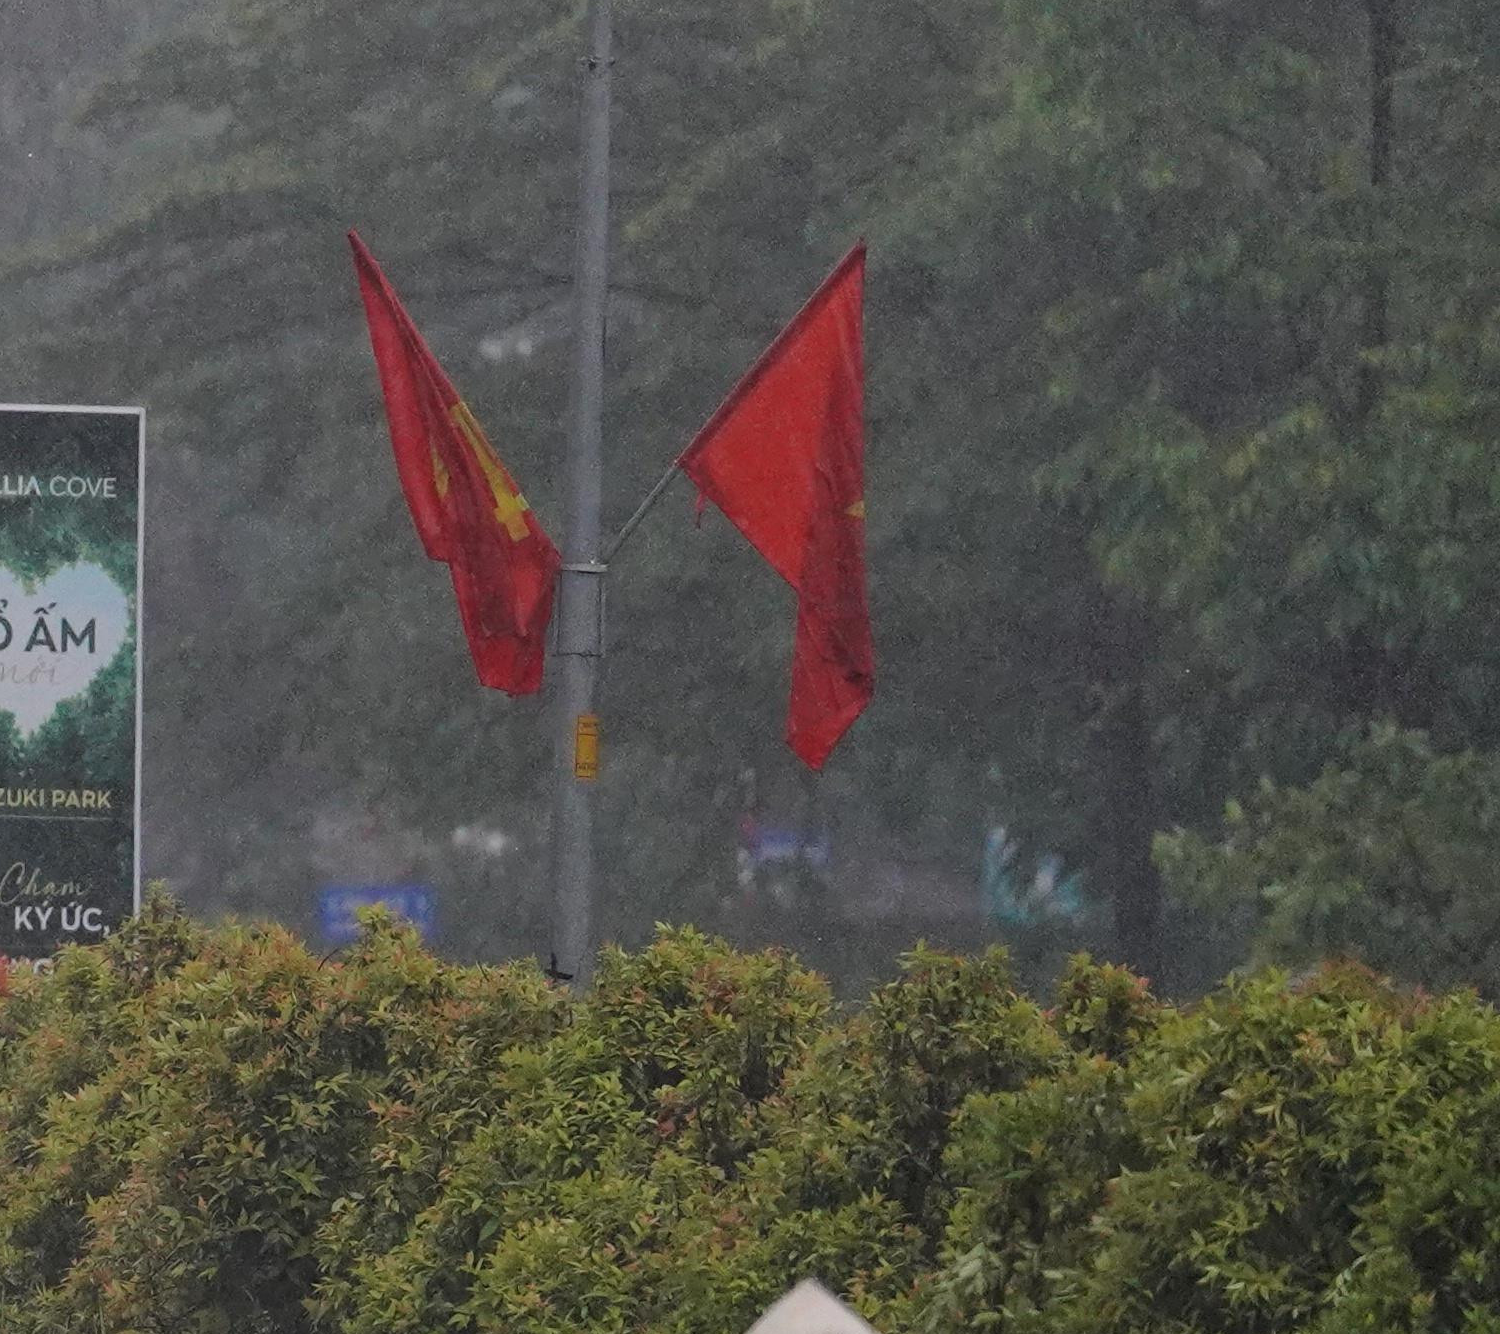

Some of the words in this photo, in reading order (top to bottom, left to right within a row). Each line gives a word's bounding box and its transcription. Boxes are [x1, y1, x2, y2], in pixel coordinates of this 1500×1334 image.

[49, 475, 117, 498] COVE
[24, 601, 96, 653] ẤM
[51, 789, 112, 809] PARK
[14, 900, 54, 931] KÝ
[61, 902, 111, 939] ỨC,
